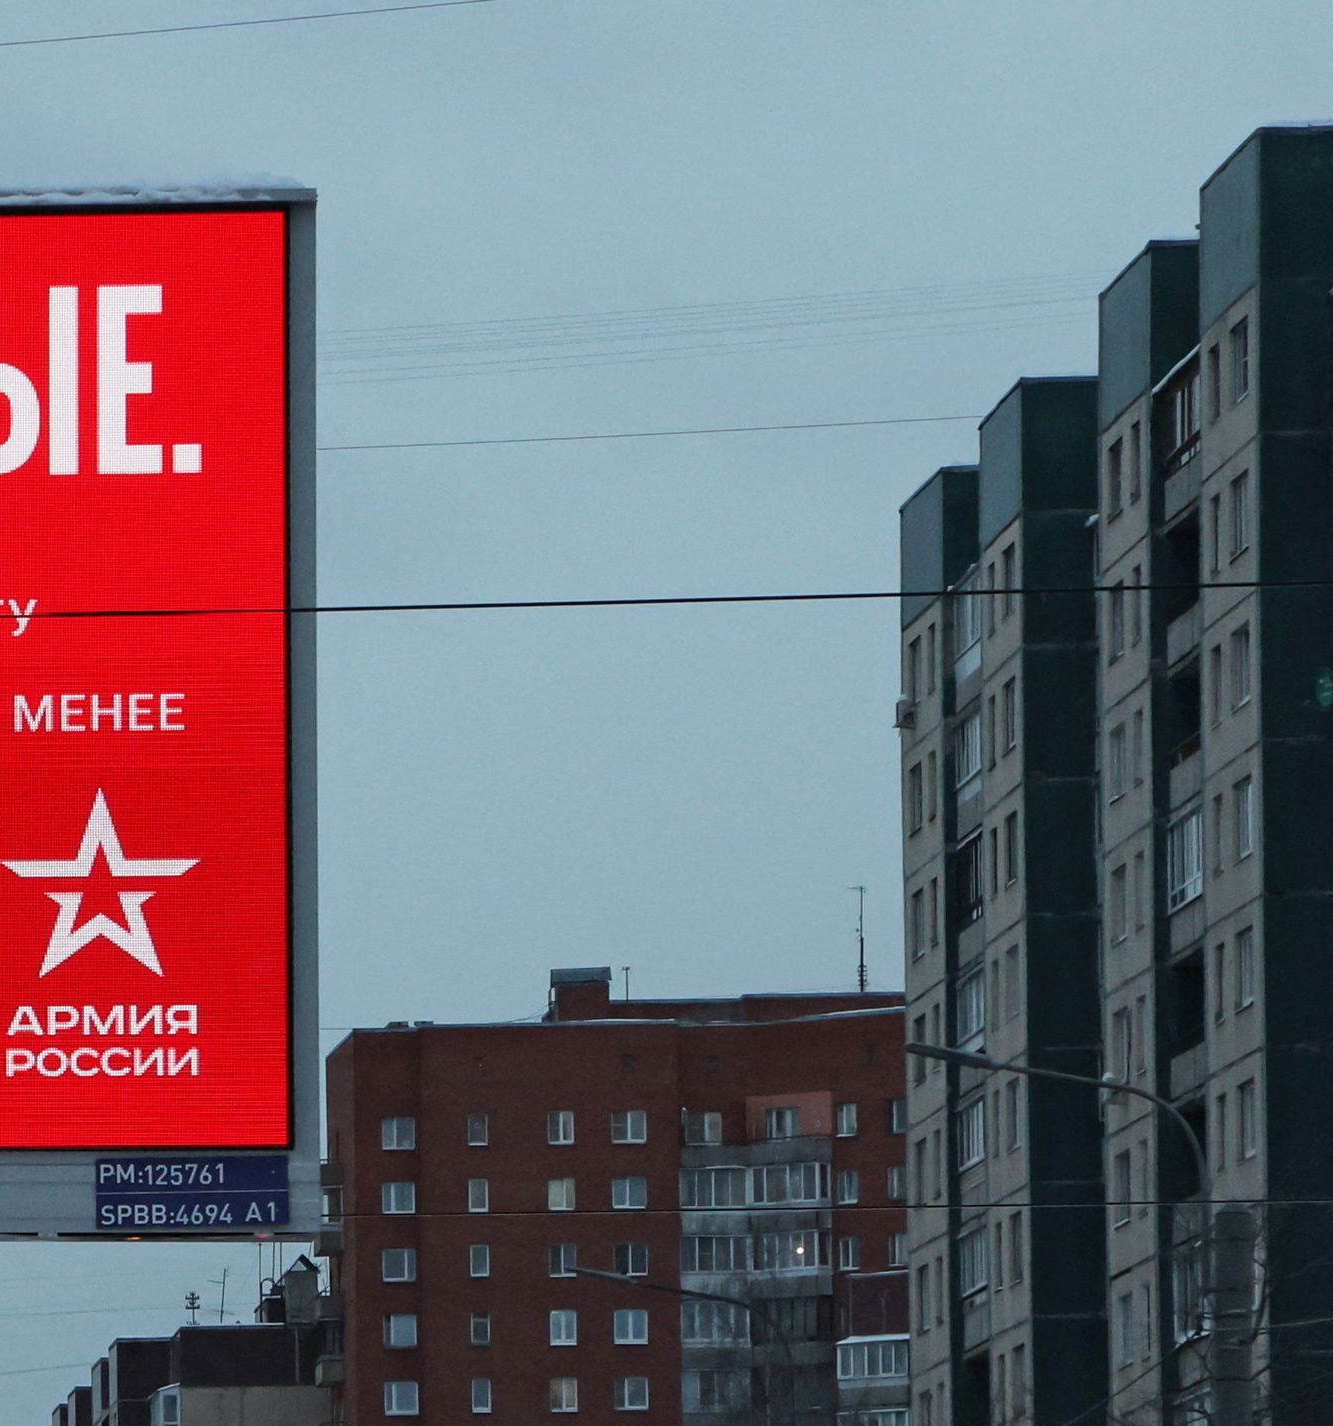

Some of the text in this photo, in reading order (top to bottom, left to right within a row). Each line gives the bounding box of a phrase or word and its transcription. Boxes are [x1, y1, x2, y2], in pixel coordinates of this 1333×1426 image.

[13, 693, 186, 733] МЕНЕЕ
[7, 1004, 198, 1036] АРМИЯ
[5, 1046, 200, 1078] РОССИИ
[101, 1202, 233, 1226] SPBB:4694
